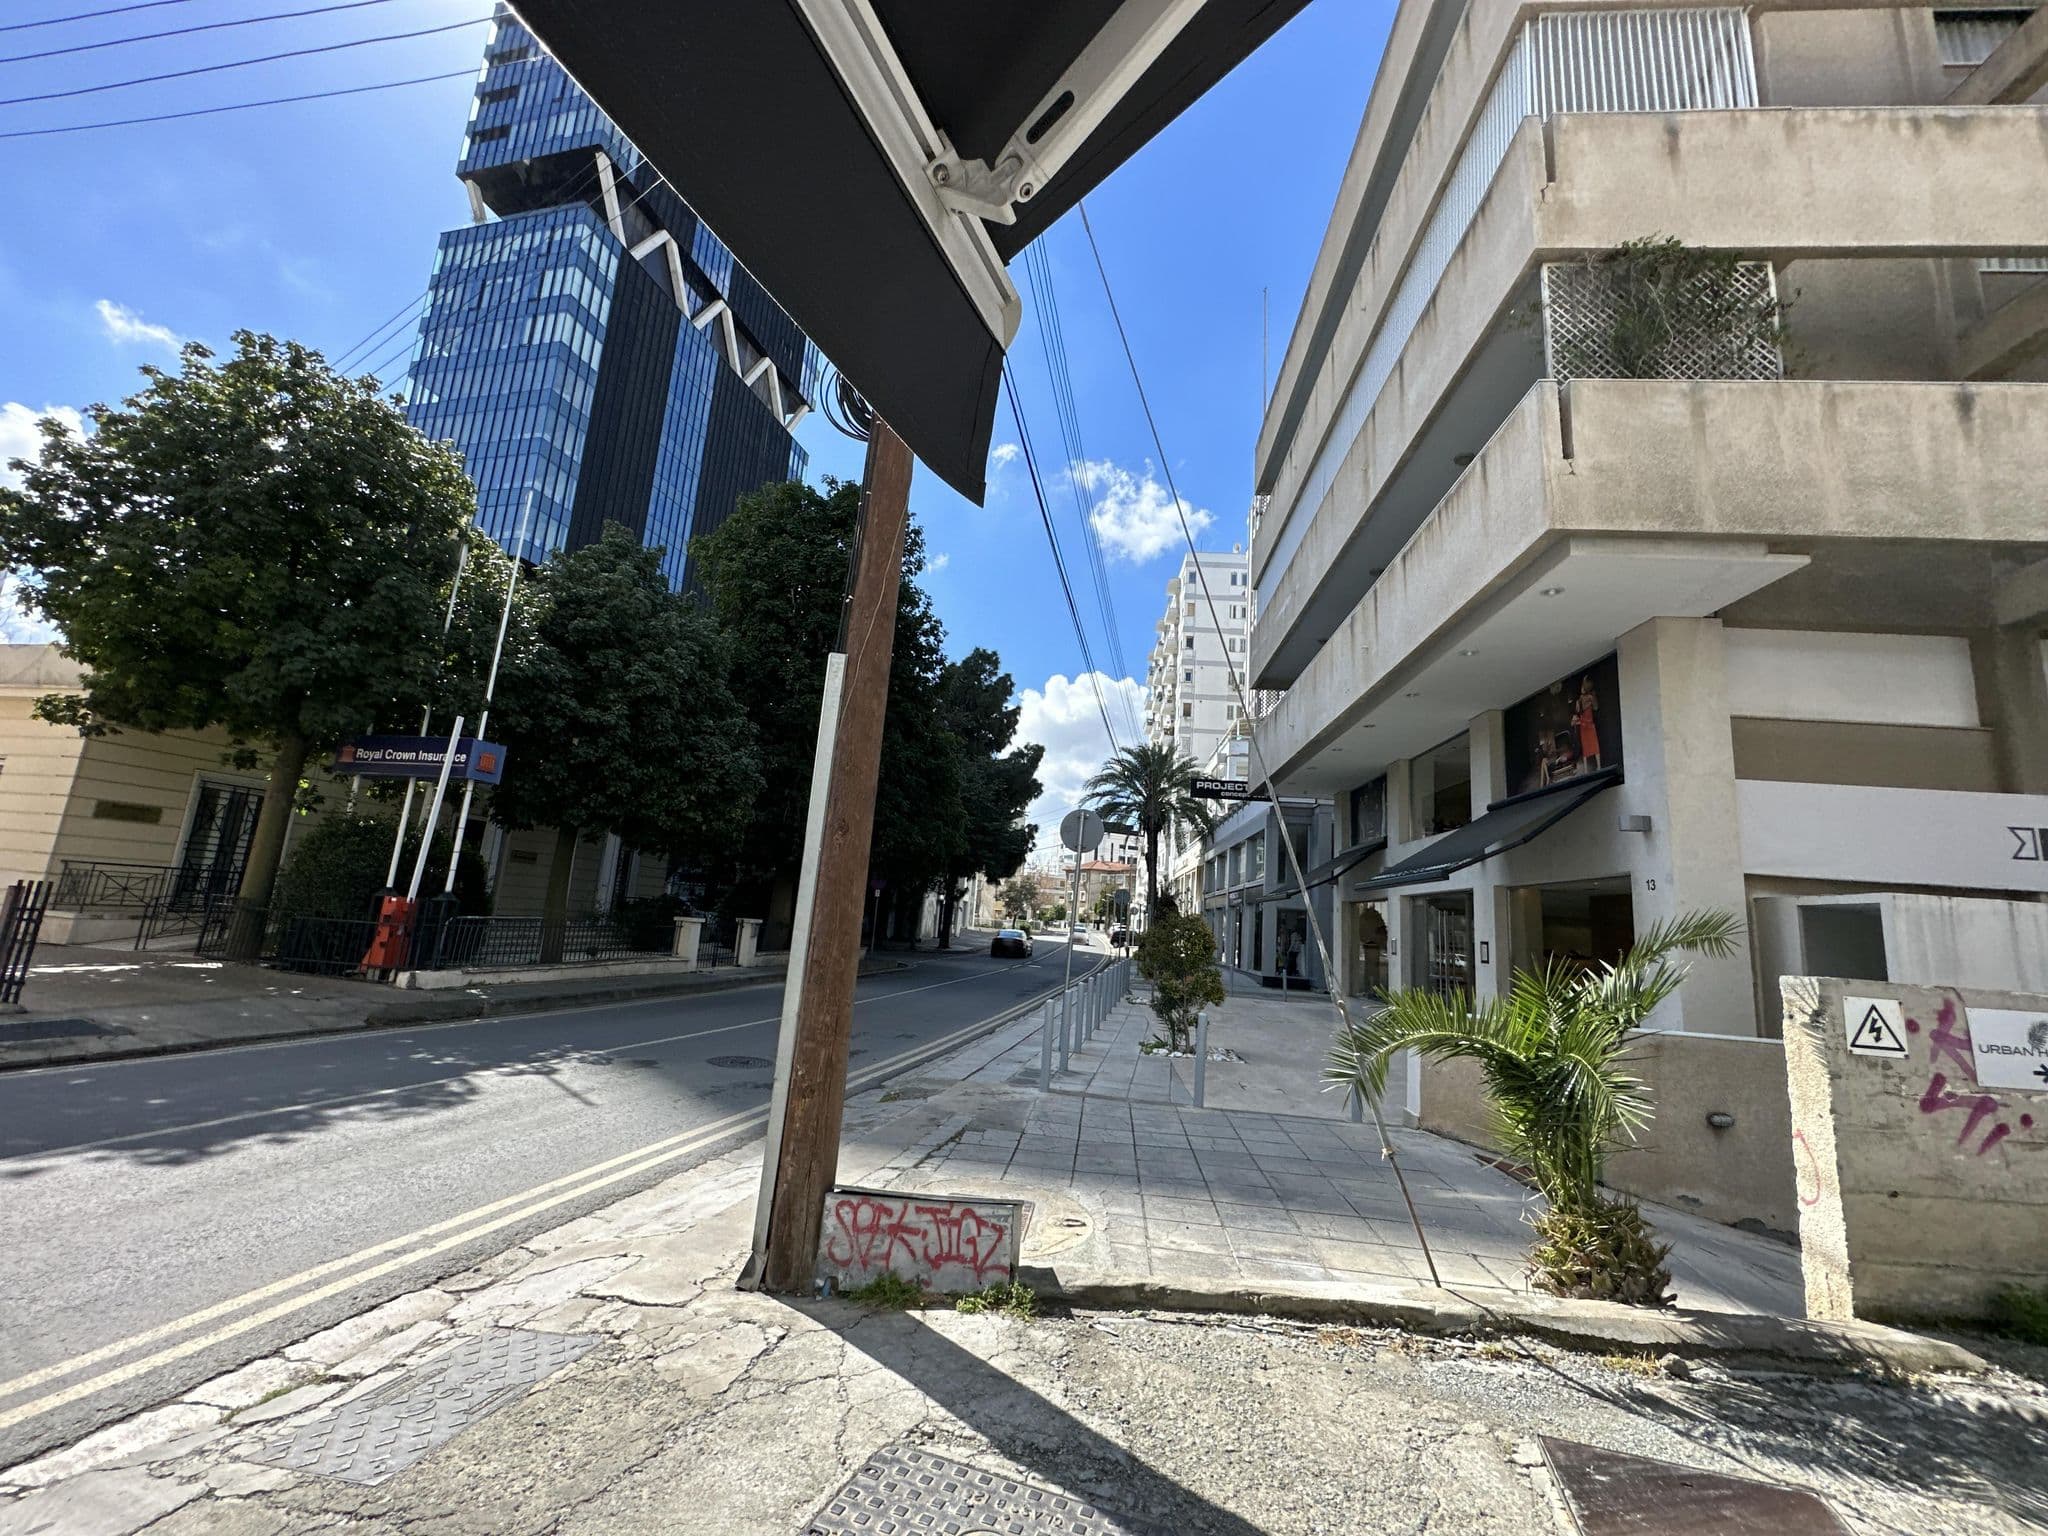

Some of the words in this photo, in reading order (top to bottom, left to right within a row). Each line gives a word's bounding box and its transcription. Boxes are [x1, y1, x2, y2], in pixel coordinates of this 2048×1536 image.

[356, 748, 383, 762] Royal
[385, 749, 416, 761] Crown
[418, 750, 467, 762] Insurace
[1646, 879, 1656, 890] 13
[1978, 1043, 2034, 1057] URBAN
